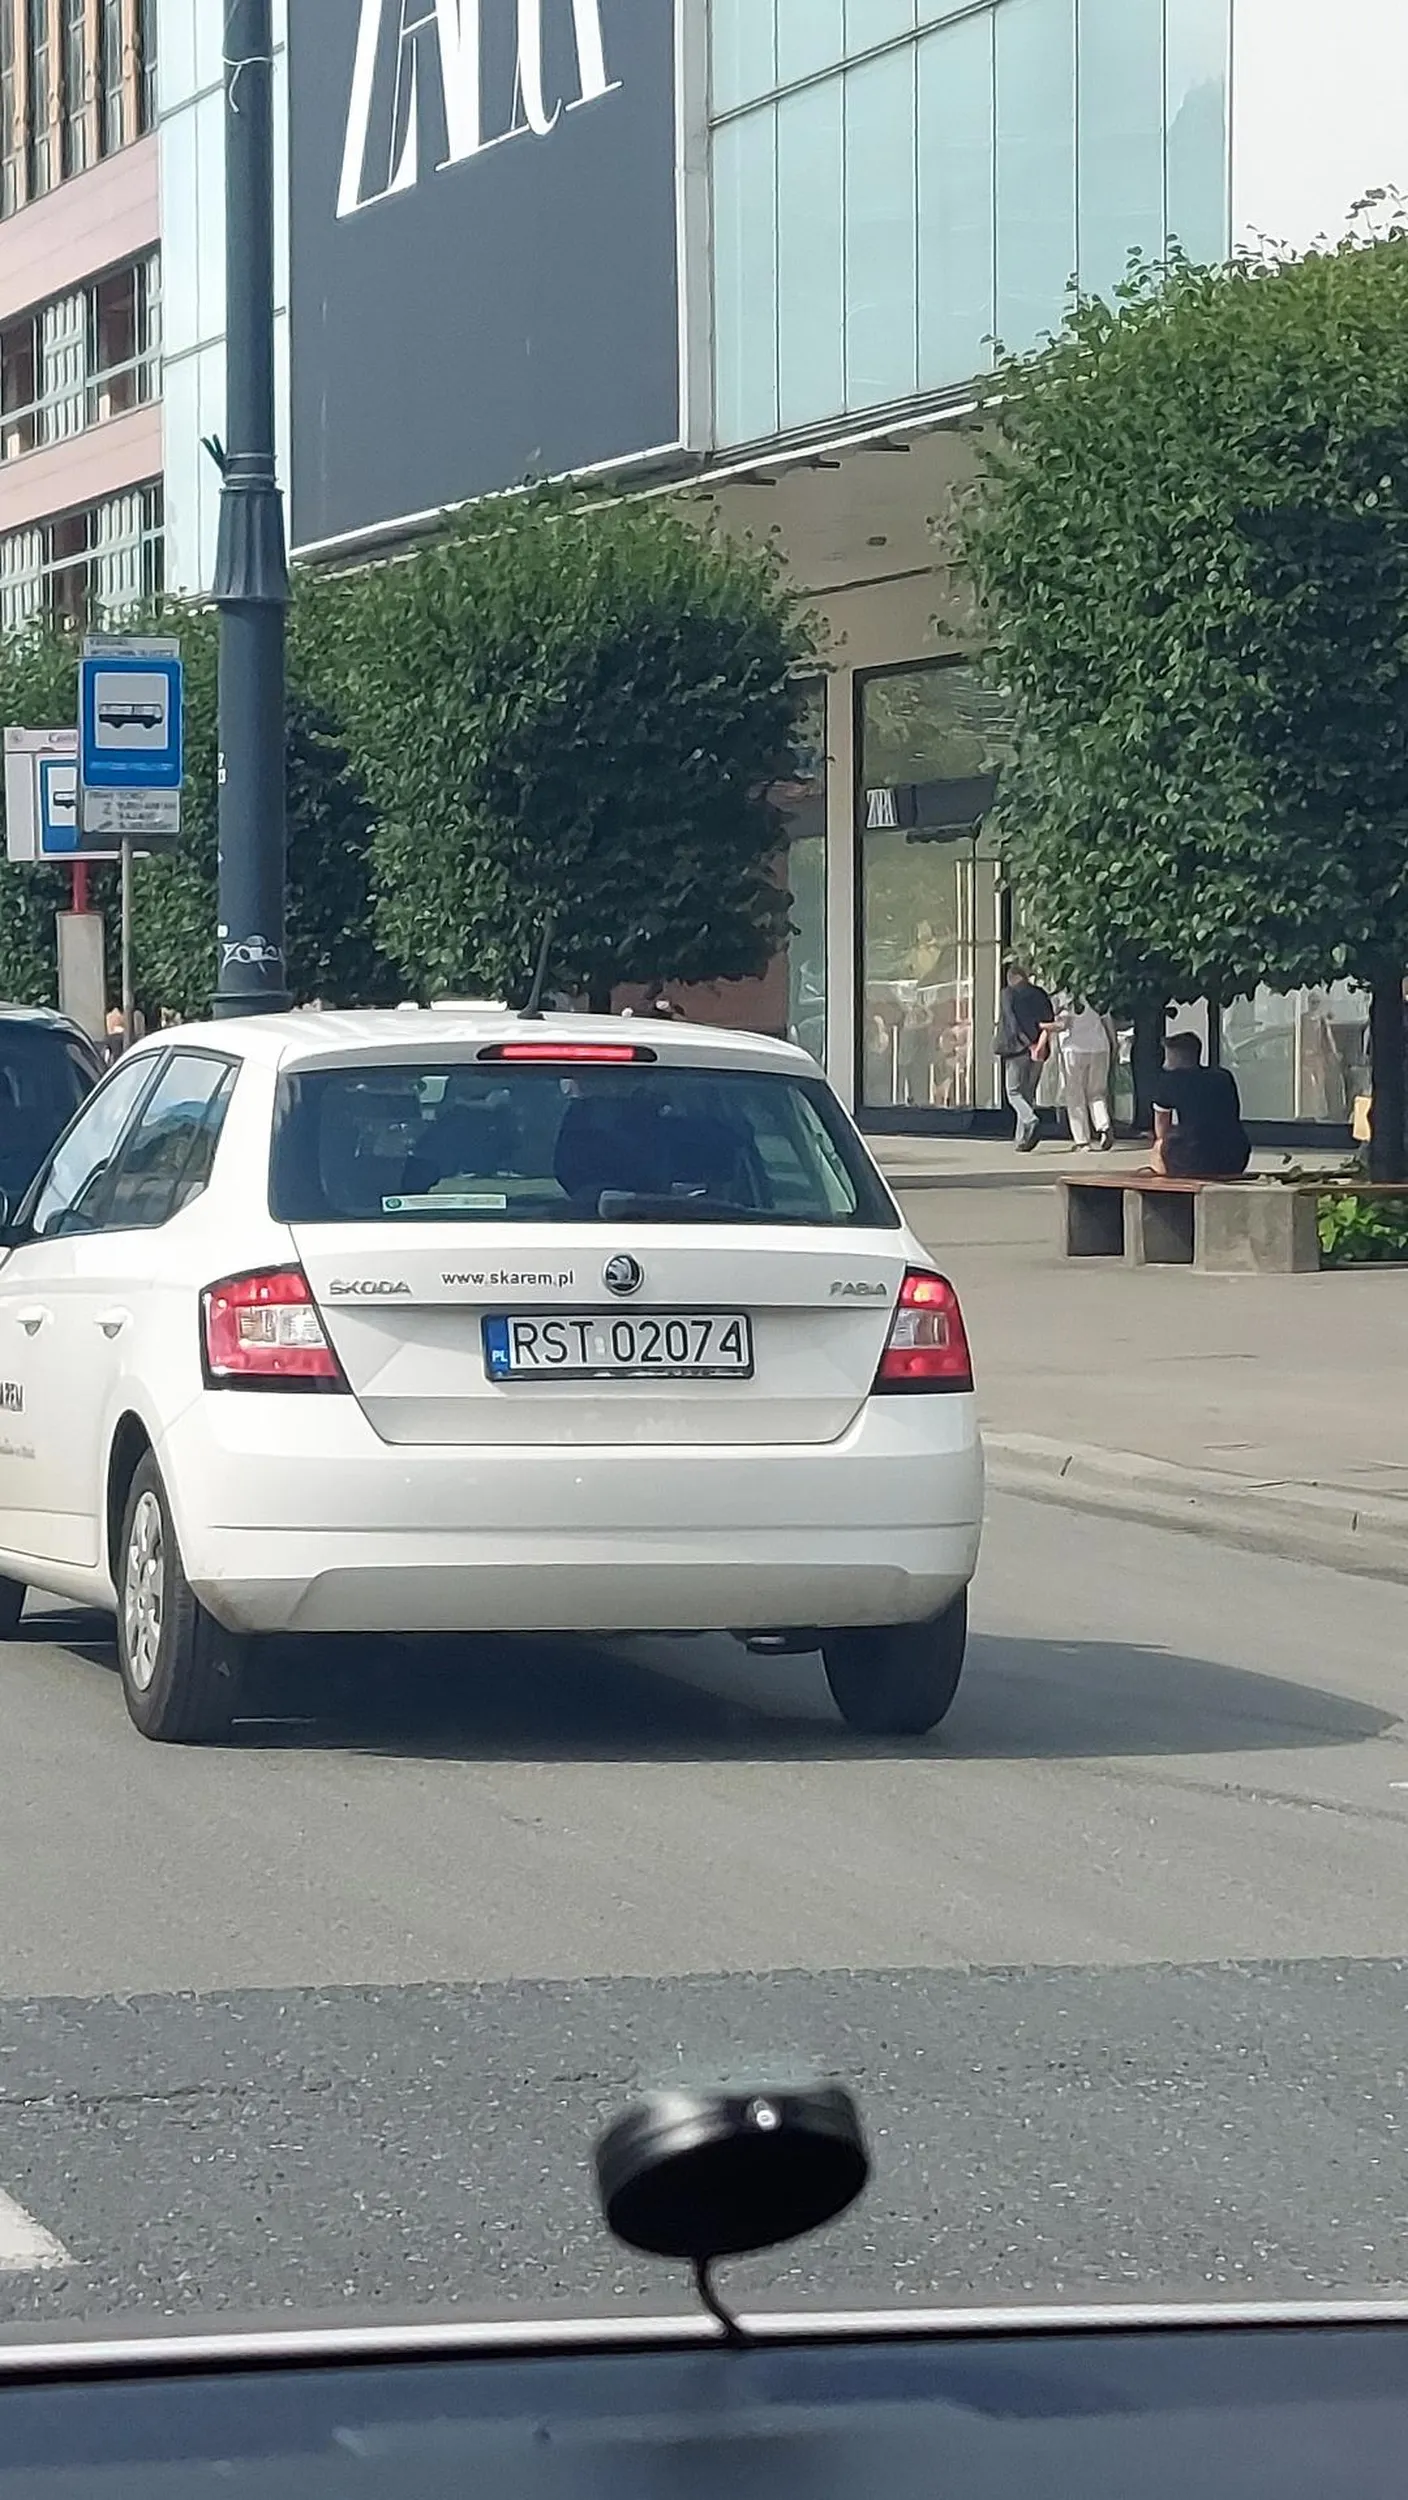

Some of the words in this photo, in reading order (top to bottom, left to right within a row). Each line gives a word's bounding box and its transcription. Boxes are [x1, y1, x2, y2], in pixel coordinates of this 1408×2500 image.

[866, 787, 898, 829] ZARA
[441, 1270, 575, 1289] www.skarem.pl
[829, 1281, 887, 1296] FABIA
[513, 1320, 595, 1365] RST
[611, 1319, 743, 1364] 02074
[492, 1351, 508, 1363] PL
